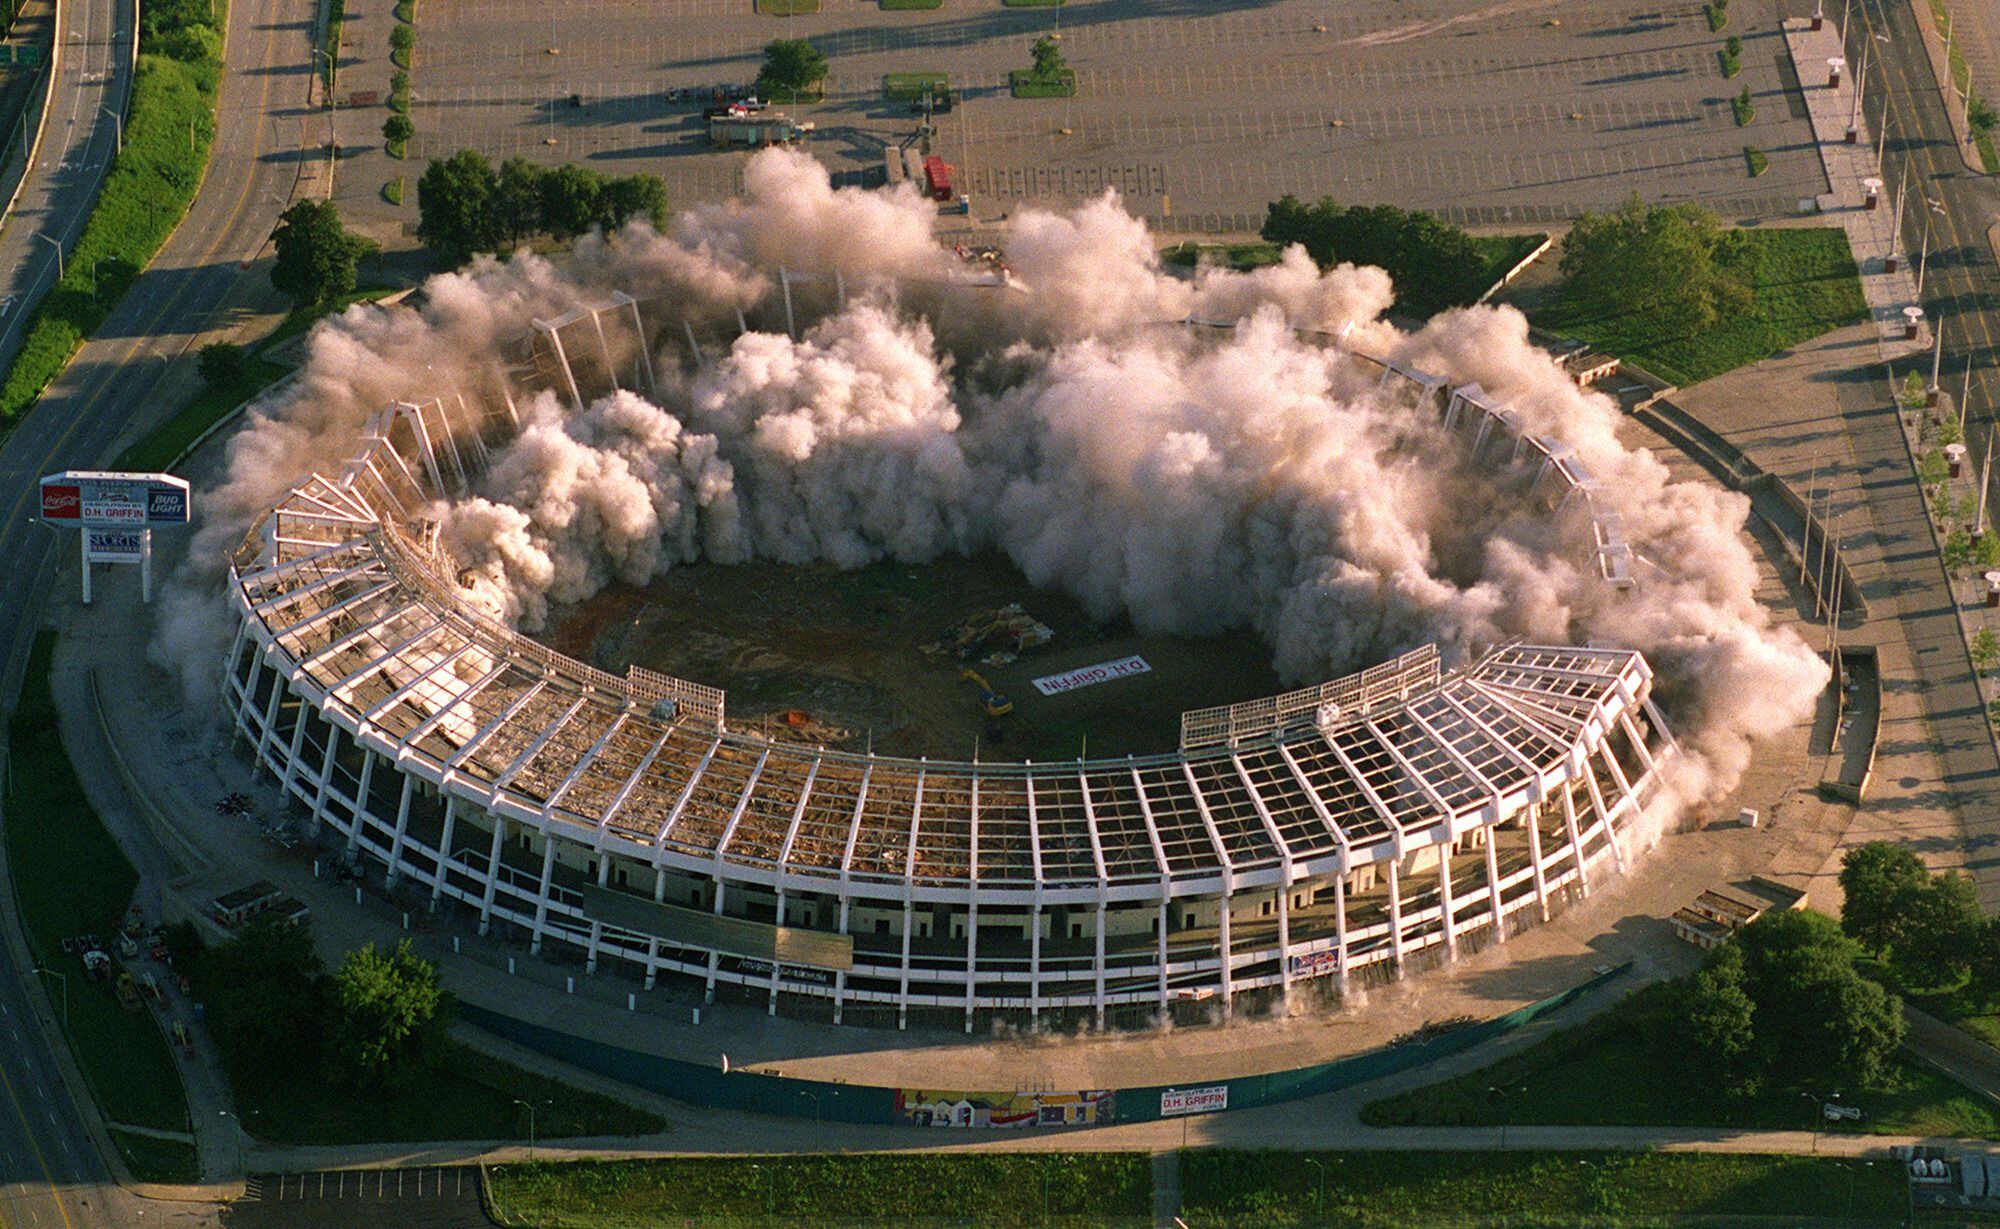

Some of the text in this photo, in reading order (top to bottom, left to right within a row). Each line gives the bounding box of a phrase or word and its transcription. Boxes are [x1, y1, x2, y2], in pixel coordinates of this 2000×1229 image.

[155, 495, 179, 504] BUD
[105, 508, 144, 518] GRIFFIN
[150, 504, 183, 513] LIGHT
[90, 535, 140, 546] SPORTS
[1042, 668, 1107, 691] GRIFFIN
[1185, 1093, 1225, 1106] GRIFFIN
